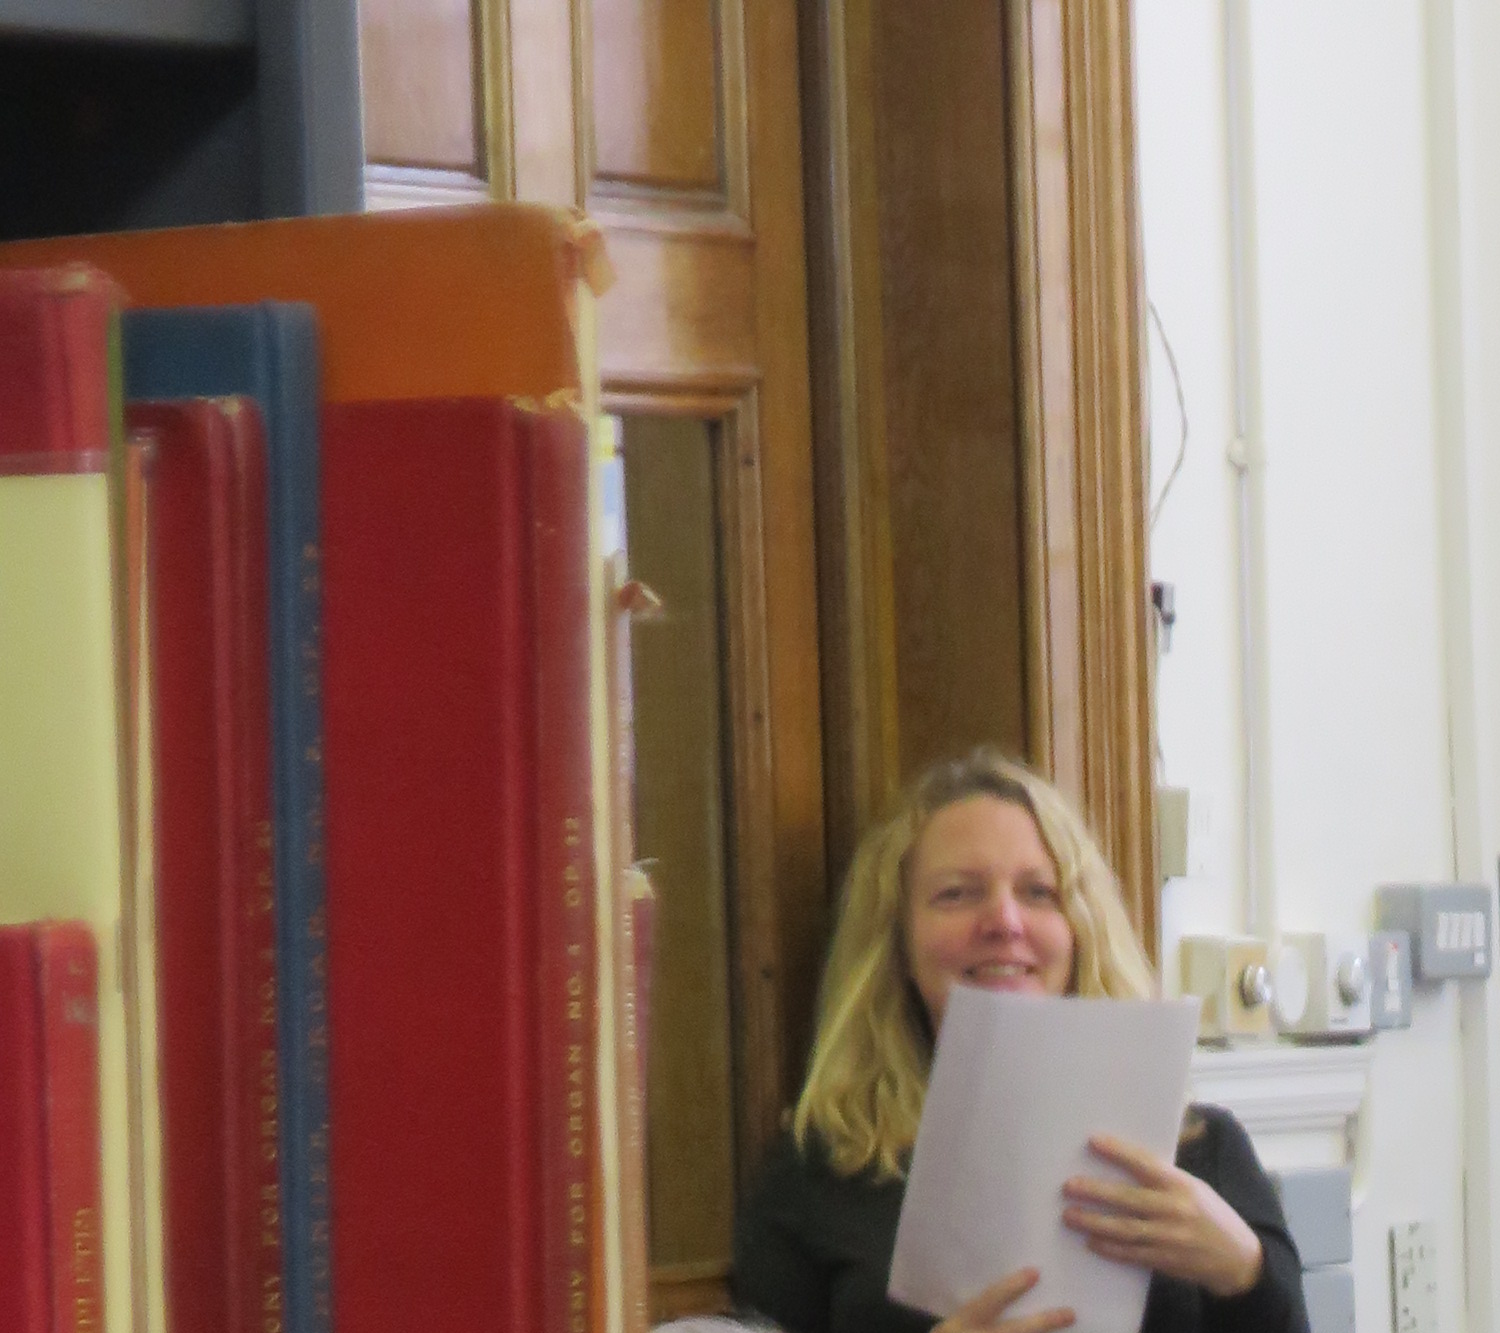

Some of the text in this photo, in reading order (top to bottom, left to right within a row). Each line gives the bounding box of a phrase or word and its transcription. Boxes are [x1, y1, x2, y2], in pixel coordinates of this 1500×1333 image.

[259, 1050, 277, 1162] ORGAN
[566, 1043, 583, 1158] ORGAN
[260, 1184, 280, 1247] FOR
[568, 1182, 586, 1246] FOR
